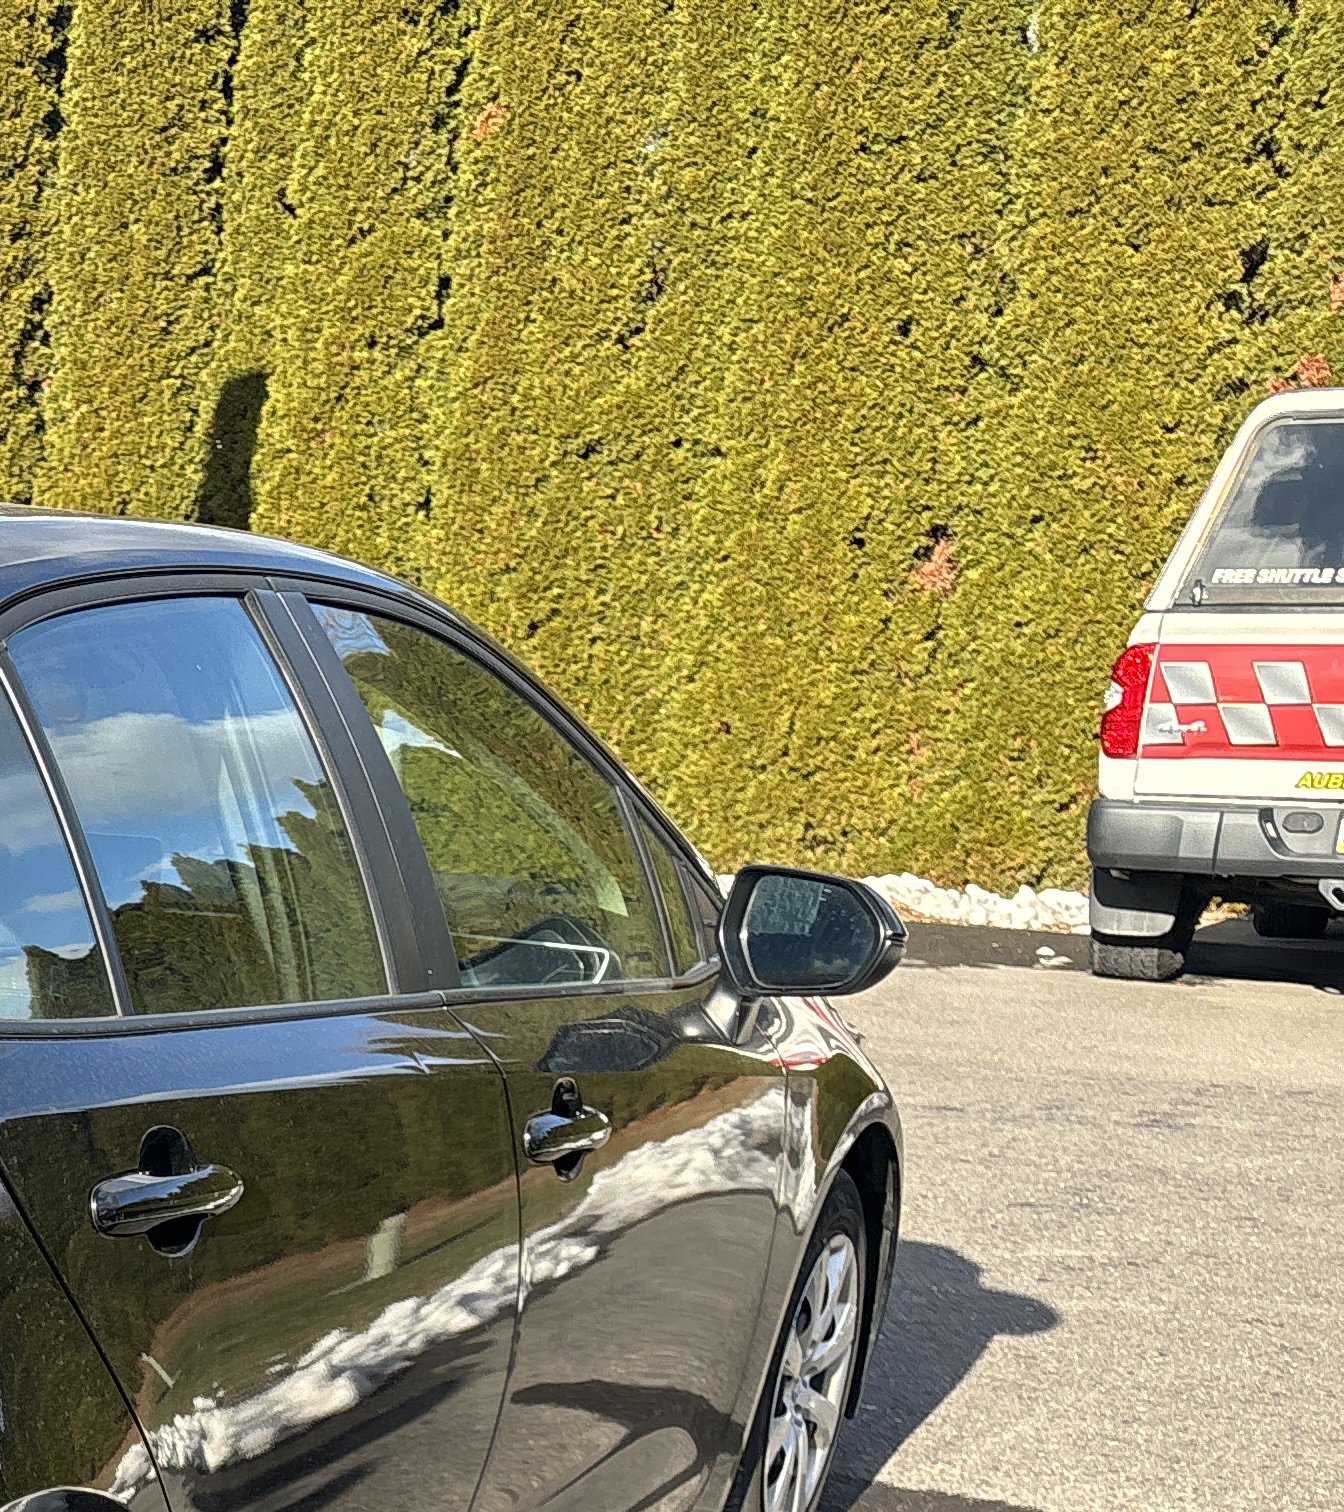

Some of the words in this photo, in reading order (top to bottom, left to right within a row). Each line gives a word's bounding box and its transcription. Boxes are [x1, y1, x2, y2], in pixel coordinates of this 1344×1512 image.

[1211, 568, 1257, 584] FREE
[1257, 568, 1336, 584] SHUTTLE
[1294, 771, 1344, 790] AUB
